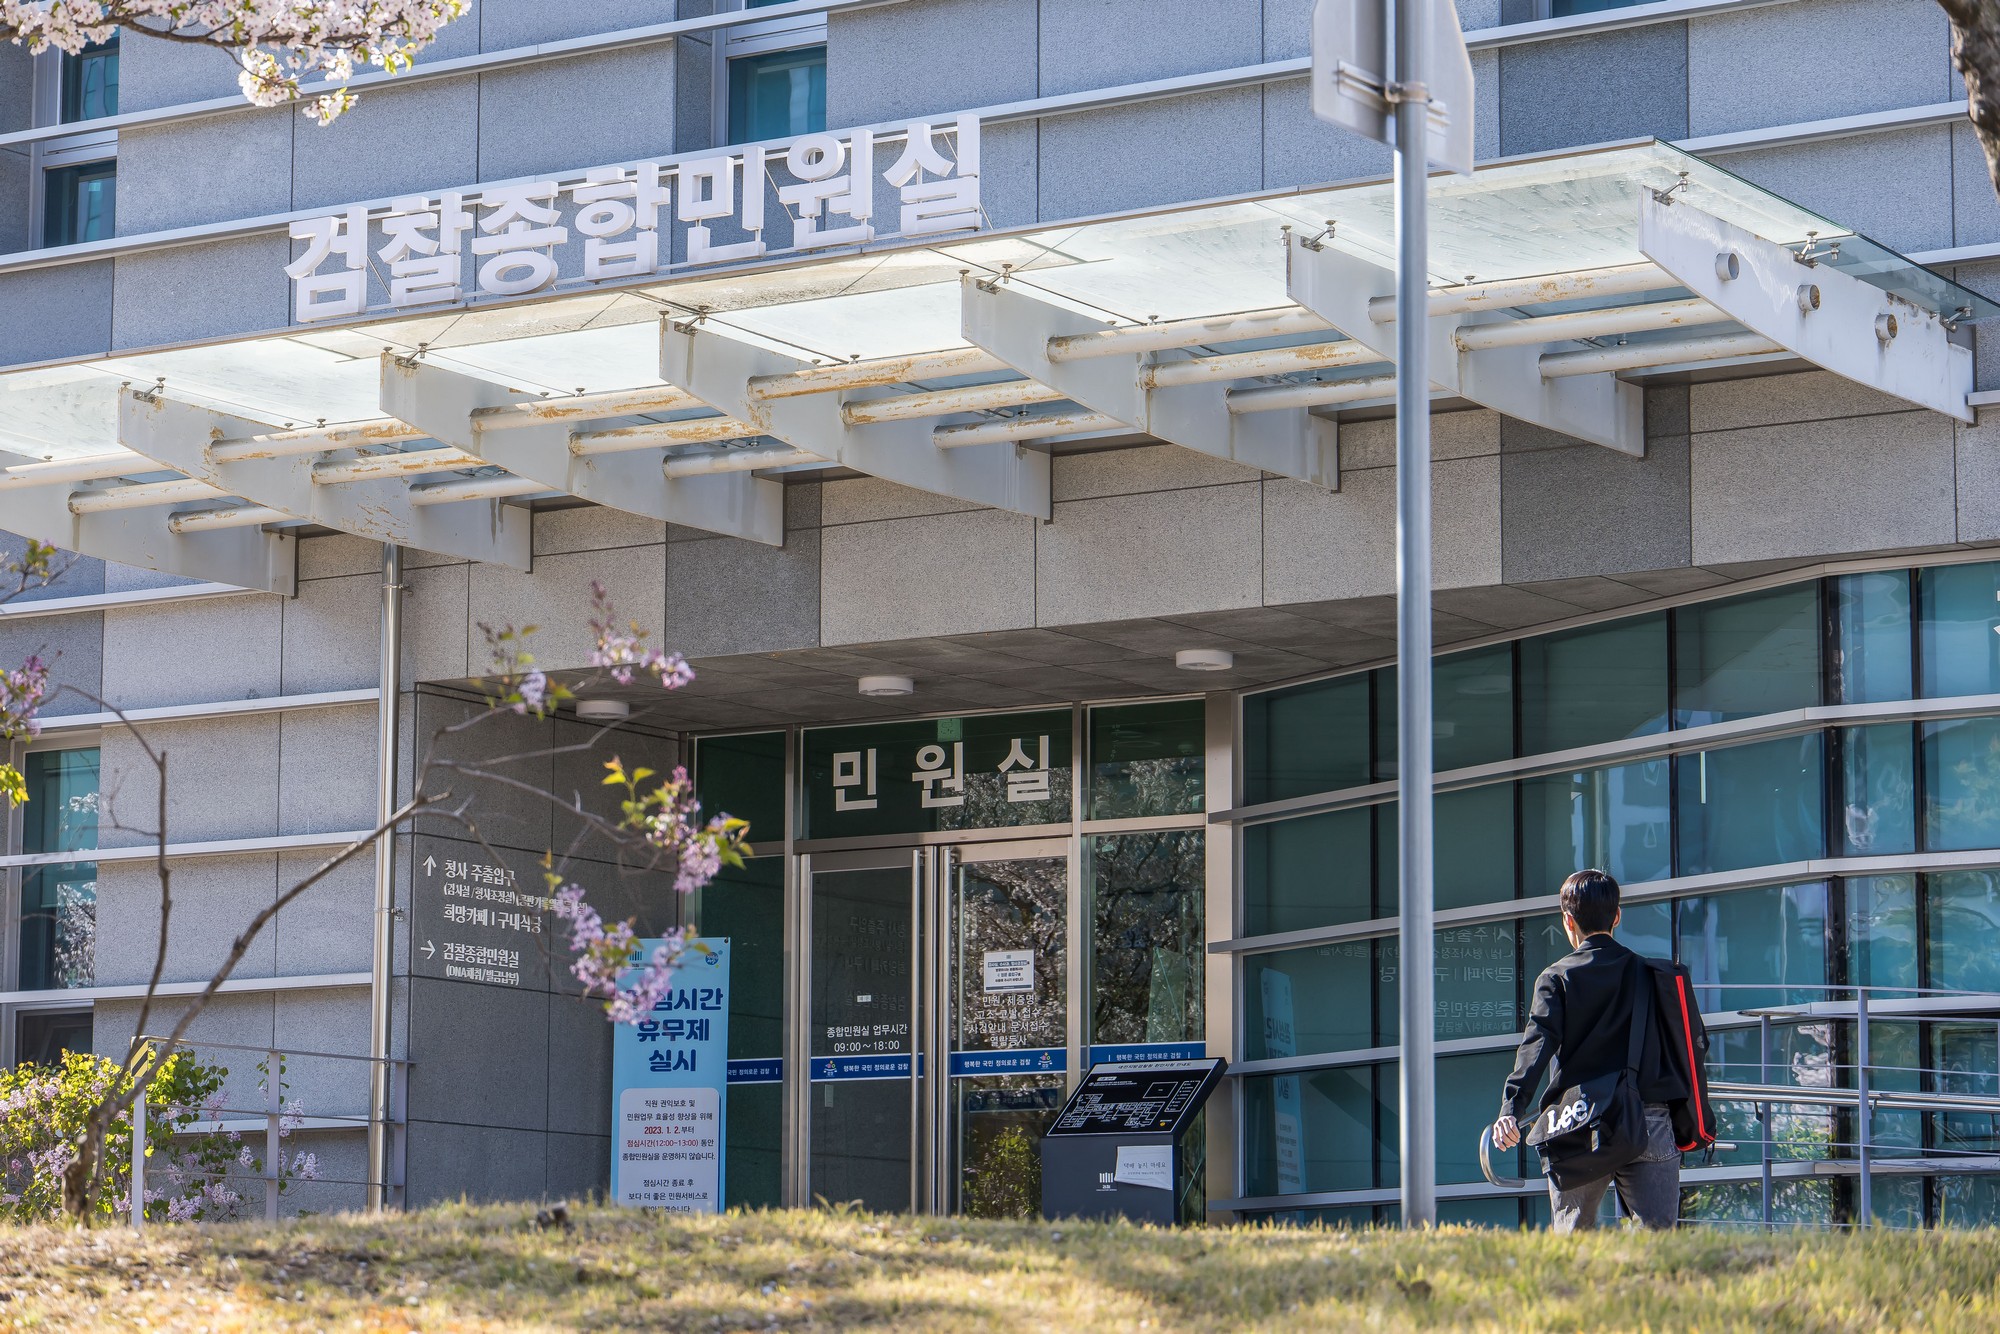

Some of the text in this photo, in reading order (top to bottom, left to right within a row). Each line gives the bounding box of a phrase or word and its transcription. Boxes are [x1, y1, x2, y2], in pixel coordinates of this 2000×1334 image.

[284, 114, 982, 323] 검찰종합민원실
[445, 859, 516, 887] 청사 주출입구
[444, 903, 542, 933] 희망카페 구내식당
[443, 942, 519, 968] 검찰종합민원실
[626, 988, 723, 1011] 심시간
[637, 1018, 710, 1042] 휴무제
[826, 1024, 908, 1038] 종합민원실 업무시간
[649, 1049, 697, 1072] 실시
[645, 1099, 696, 1108] 직원 권익보호 및
[627, 1112, 713, 1121] 민원업무 효율성 향상을 위해
[1547, 1100, 1587, 1134] Lee
[644, 1126, 664, 1135] 2023.
[700, 1139, 714, 1147] 동안
[622, 1152, 716, 1161] 종합민원실을 운영하지 않습니다.
[643, 1179, 694, 1187] 점심시간 종료 후
[628, 1192, 709, 1200] 보다 더 좋은 민원서비스로
